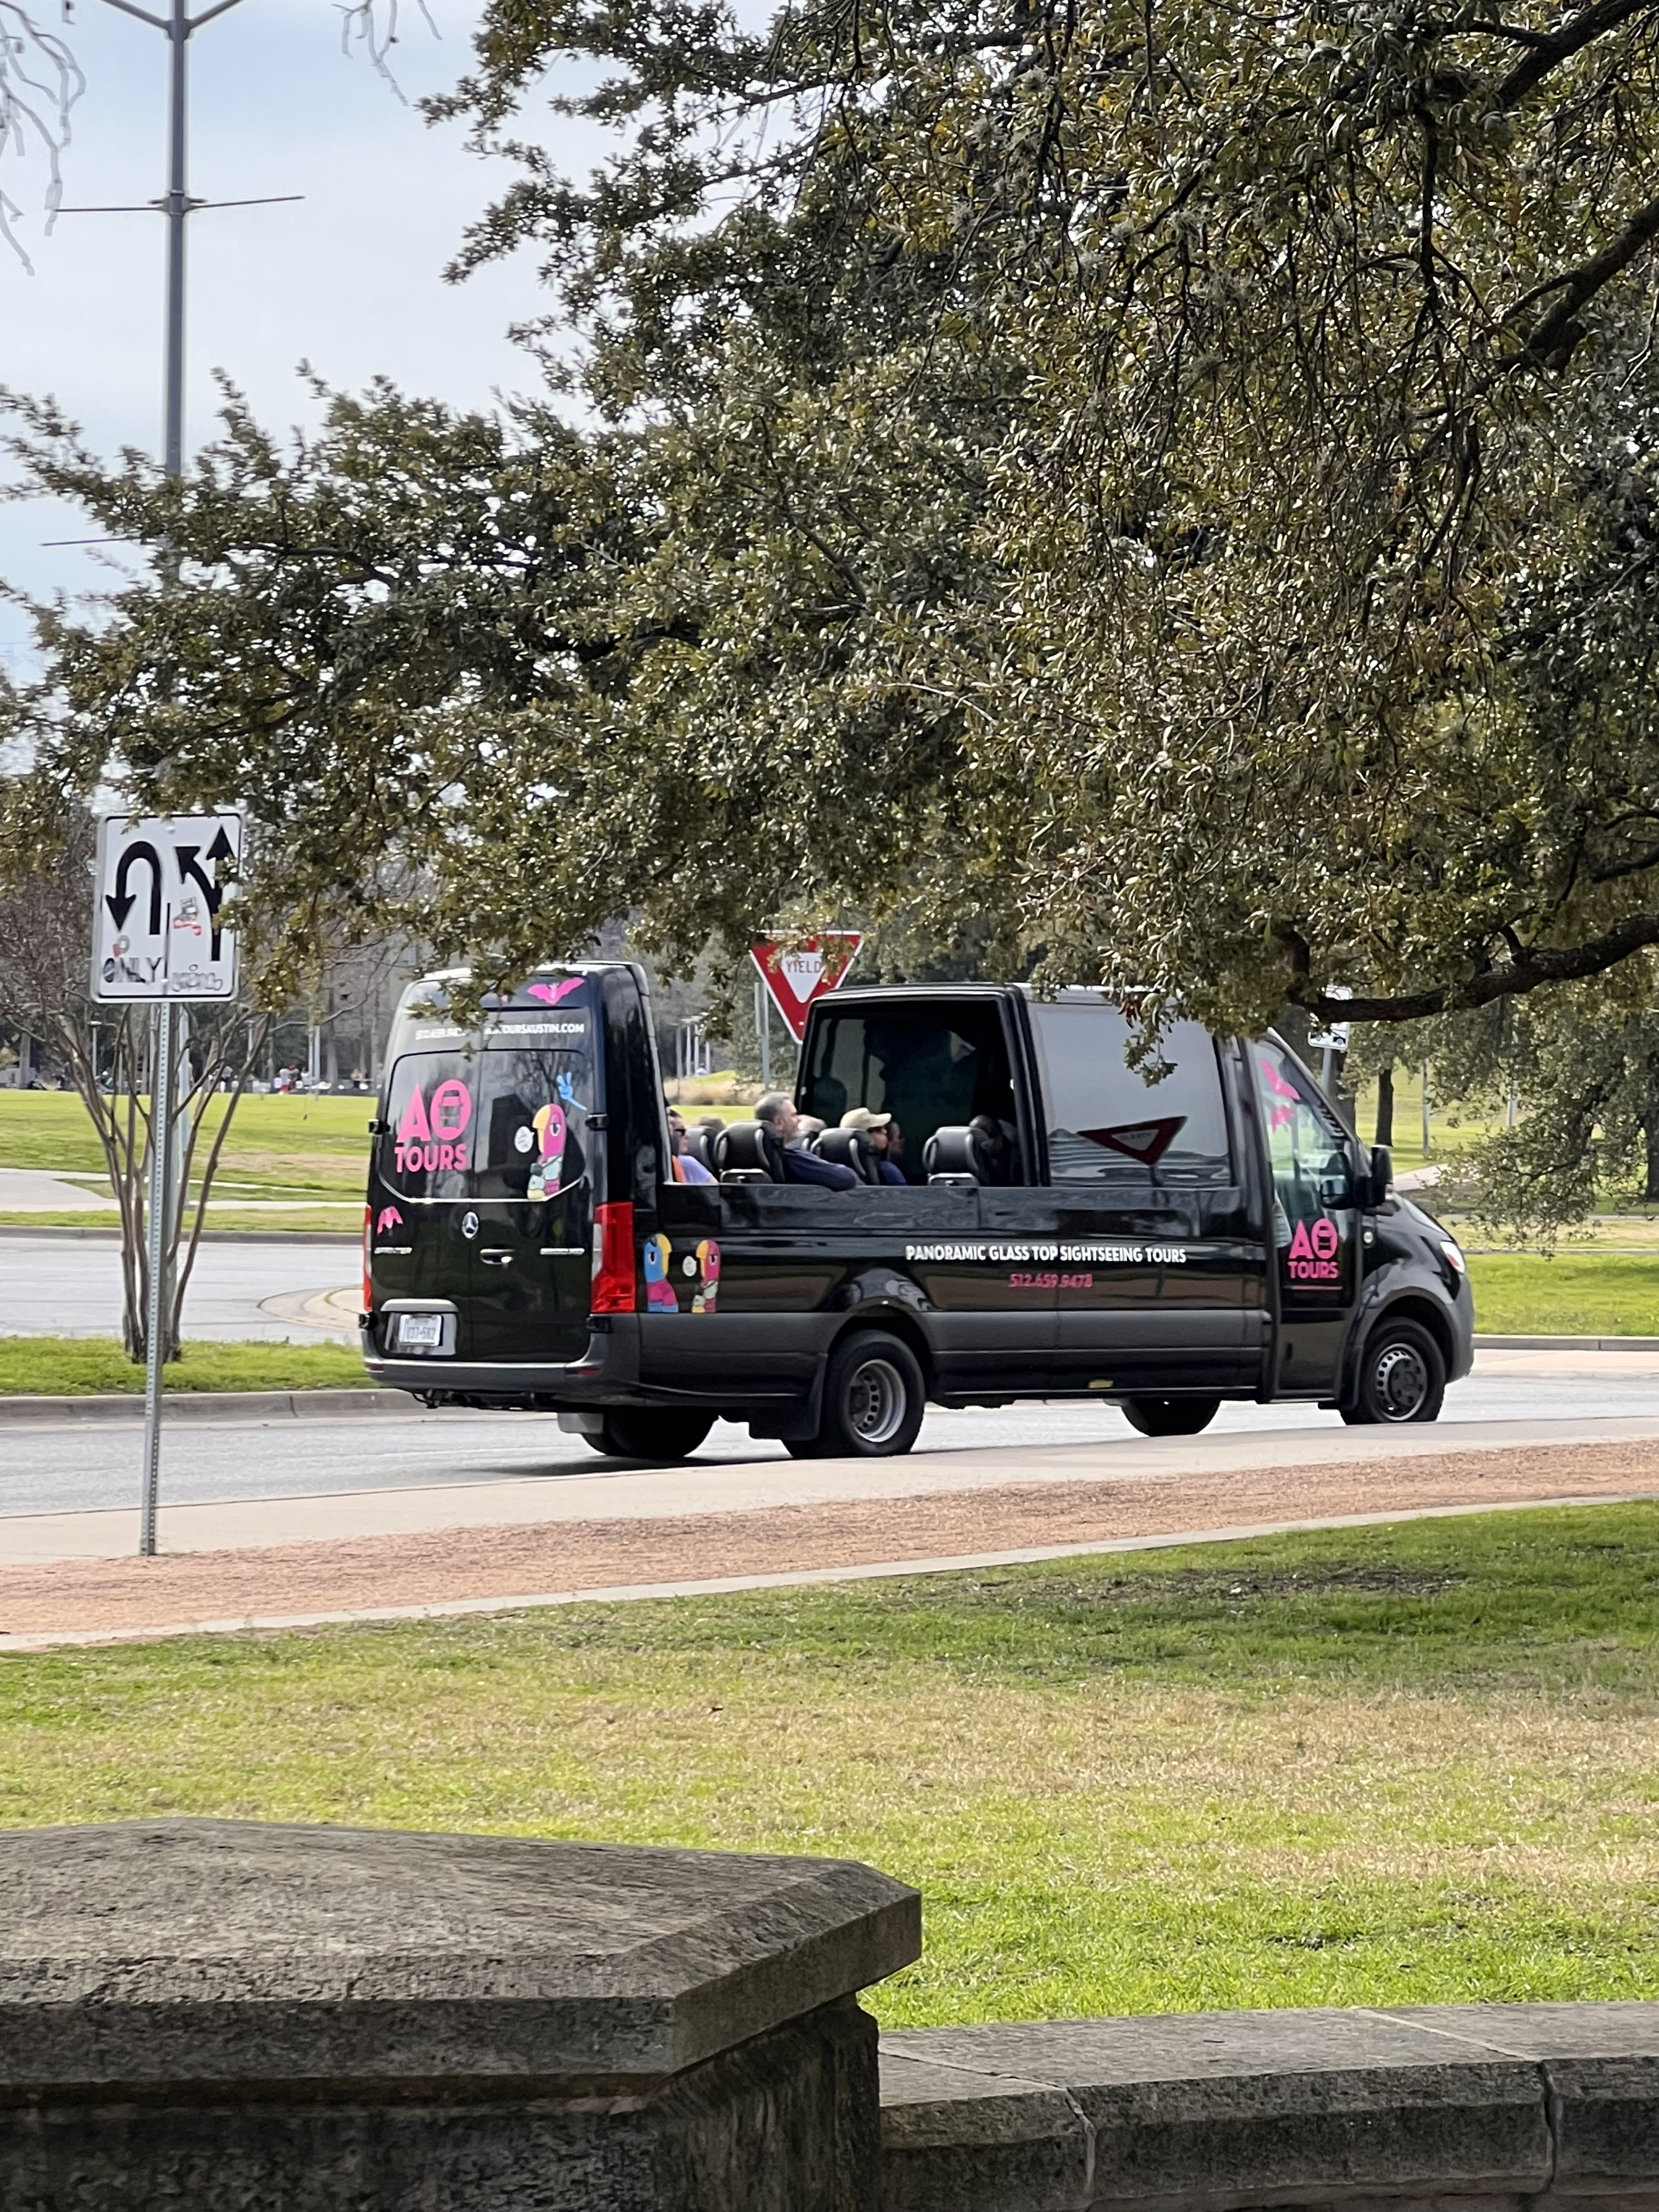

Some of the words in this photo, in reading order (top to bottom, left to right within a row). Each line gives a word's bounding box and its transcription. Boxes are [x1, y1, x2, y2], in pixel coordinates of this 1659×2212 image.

[786, 961, 822, 973] YIELD
[394, 1144, 468, 1173] TOURS
[905, 1245, 986, 1260] PANORAMIC
[989, 1246, 1030, 1261] GLASS
[1031, 1246, 1058, 1261] TOP
[1059, 1246, 1143, 1262] SIGHTSEEING
[1145, 1248, 1187, 1262] TOURS
[1288, 1261, 1338, 1278] TOURS
